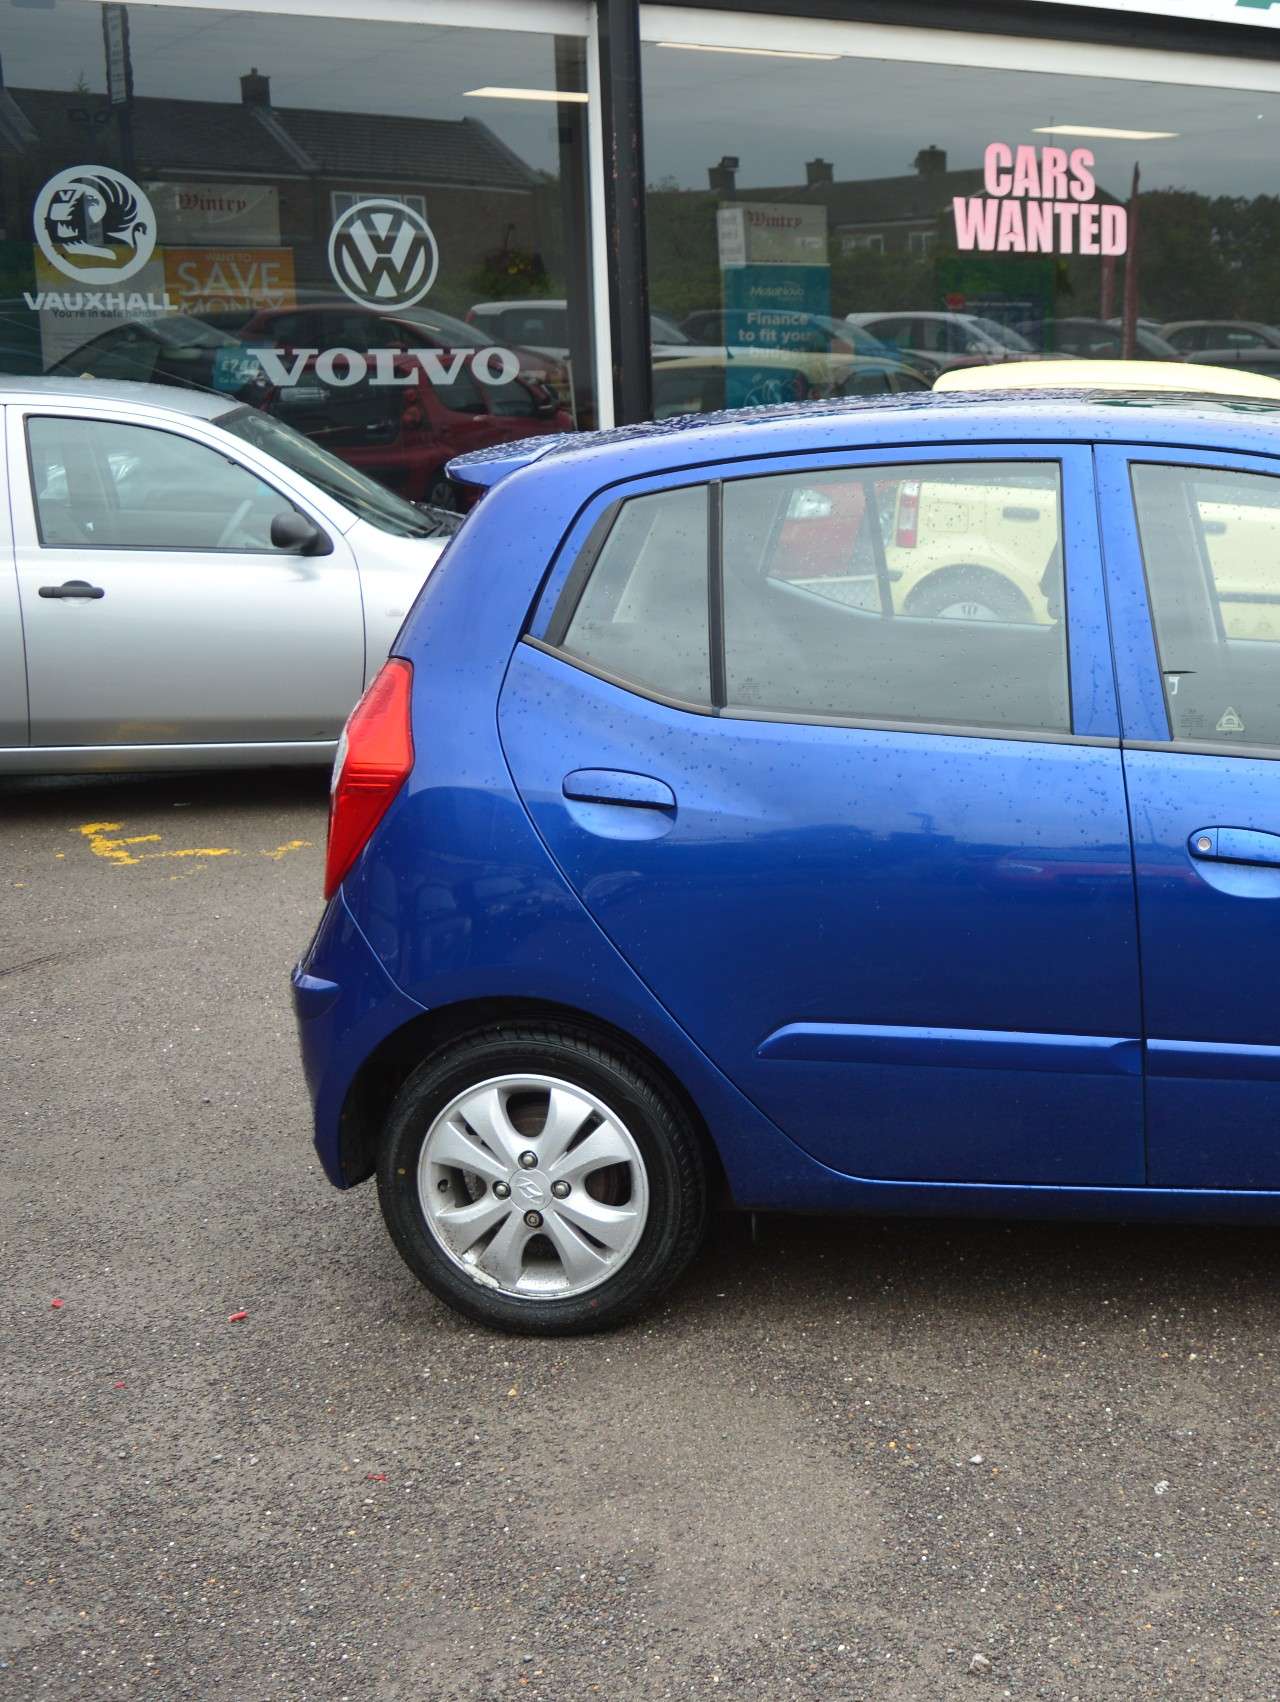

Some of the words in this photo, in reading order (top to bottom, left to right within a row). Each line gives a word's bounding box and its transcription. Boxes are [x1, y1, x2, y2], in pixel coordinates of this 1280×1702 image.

[984, 142, 1096, 201] CARS
[953, 197, 1128, 256] WANTED
[178, 262, 283, 296] SAVE
[23, 292, 178, 310] VAUXHALL
[738, 329, 755, 341] to
[759, 328, 777, 341] fit
[747, 312, 809, 325] Finance
[247, 347, 520, 386] VOLVO
